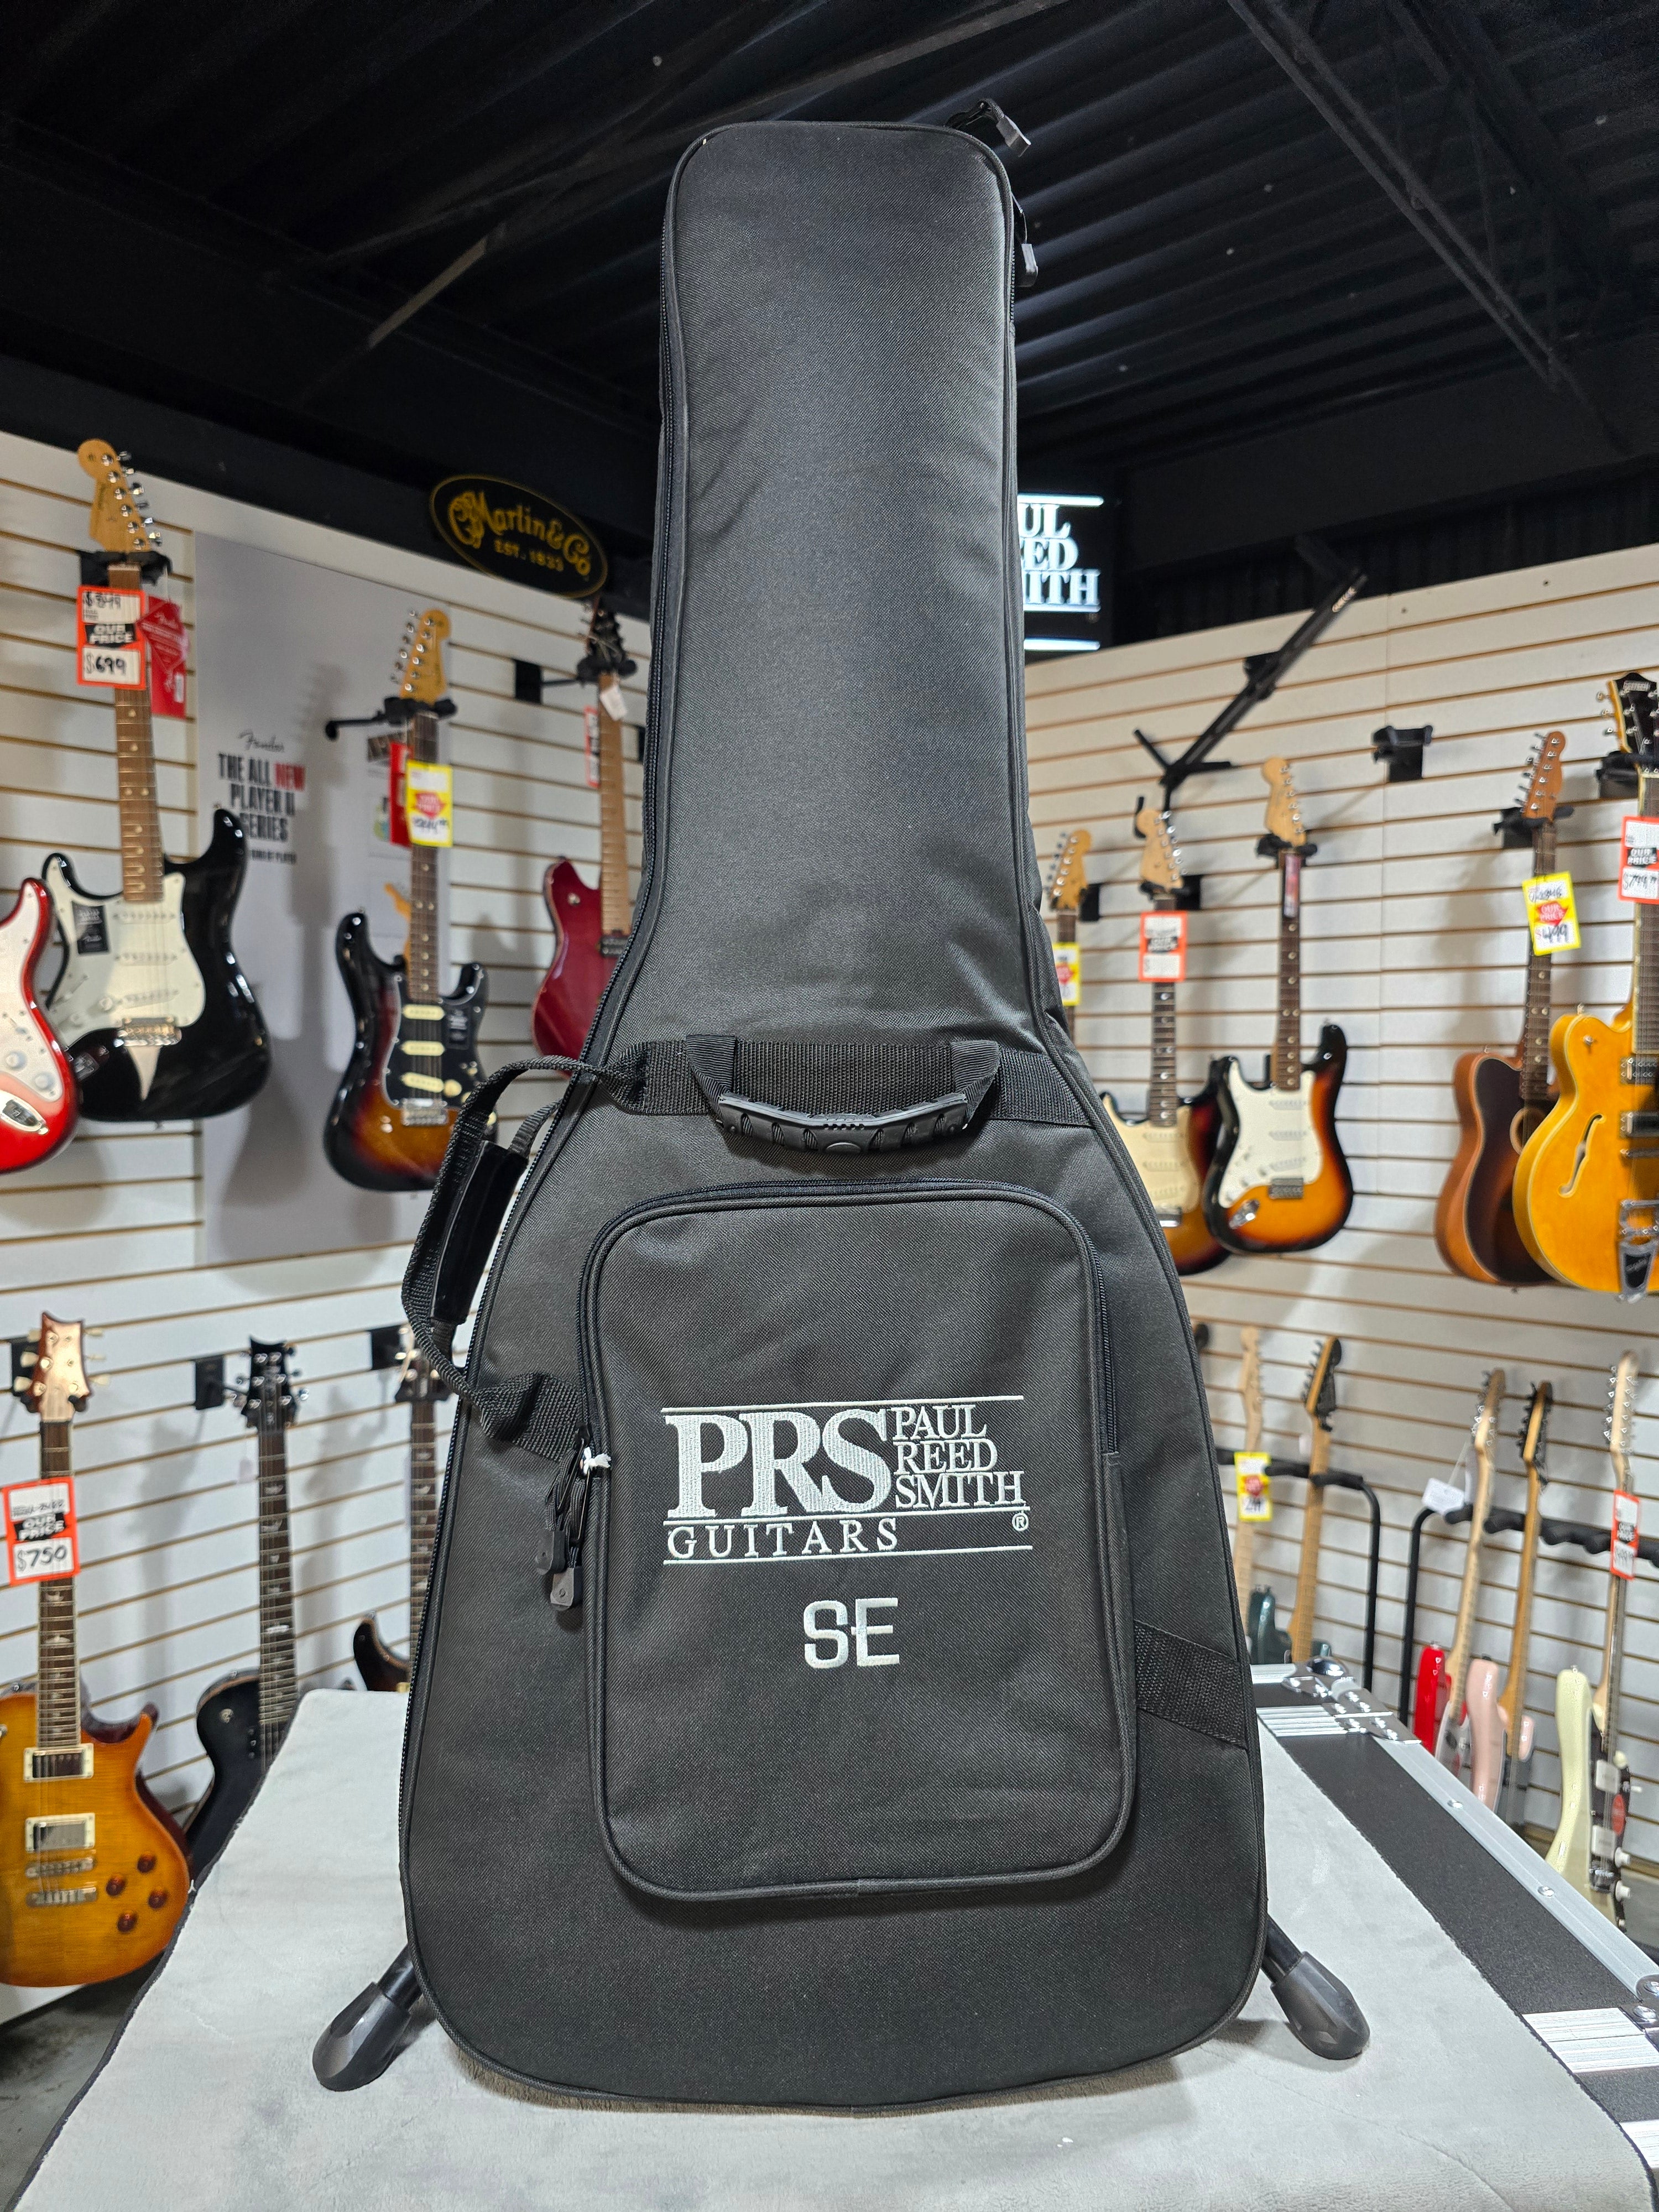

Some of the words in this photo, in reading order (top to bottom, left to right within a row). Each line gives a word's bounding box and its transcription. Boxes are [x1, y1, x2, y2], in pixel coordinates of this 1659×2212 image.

[1017, 503, 1071, 539] UL
[1020, 538, 1079, 572] ED
[1022, 568, 1101, 606] ITH
[90, 633, 134, 645] PRICE
[94, 624, 126, 635] OUR
[218, 753, 243, 782] THE
[248, 757, 270, 786] ALL
[231, 784, 281, 813] PLAYER
[239, 812, 288, 843] SERIES
[891, 1405, 987, 1440] PAUL
[665, 1408, 891, 1519] PRS
[893, 1438, 998, 1475] REED
[895, 1471, 1026, 1509] SMITH
[18, 1520, 65, 1541] PRICE
[22, 1515, 56, 1530] OUR
[667, 1518, 898, 1559] GUITARS
[17, 1545, 67, 1572] $750
[803, 1597, 900, 1669] SE
